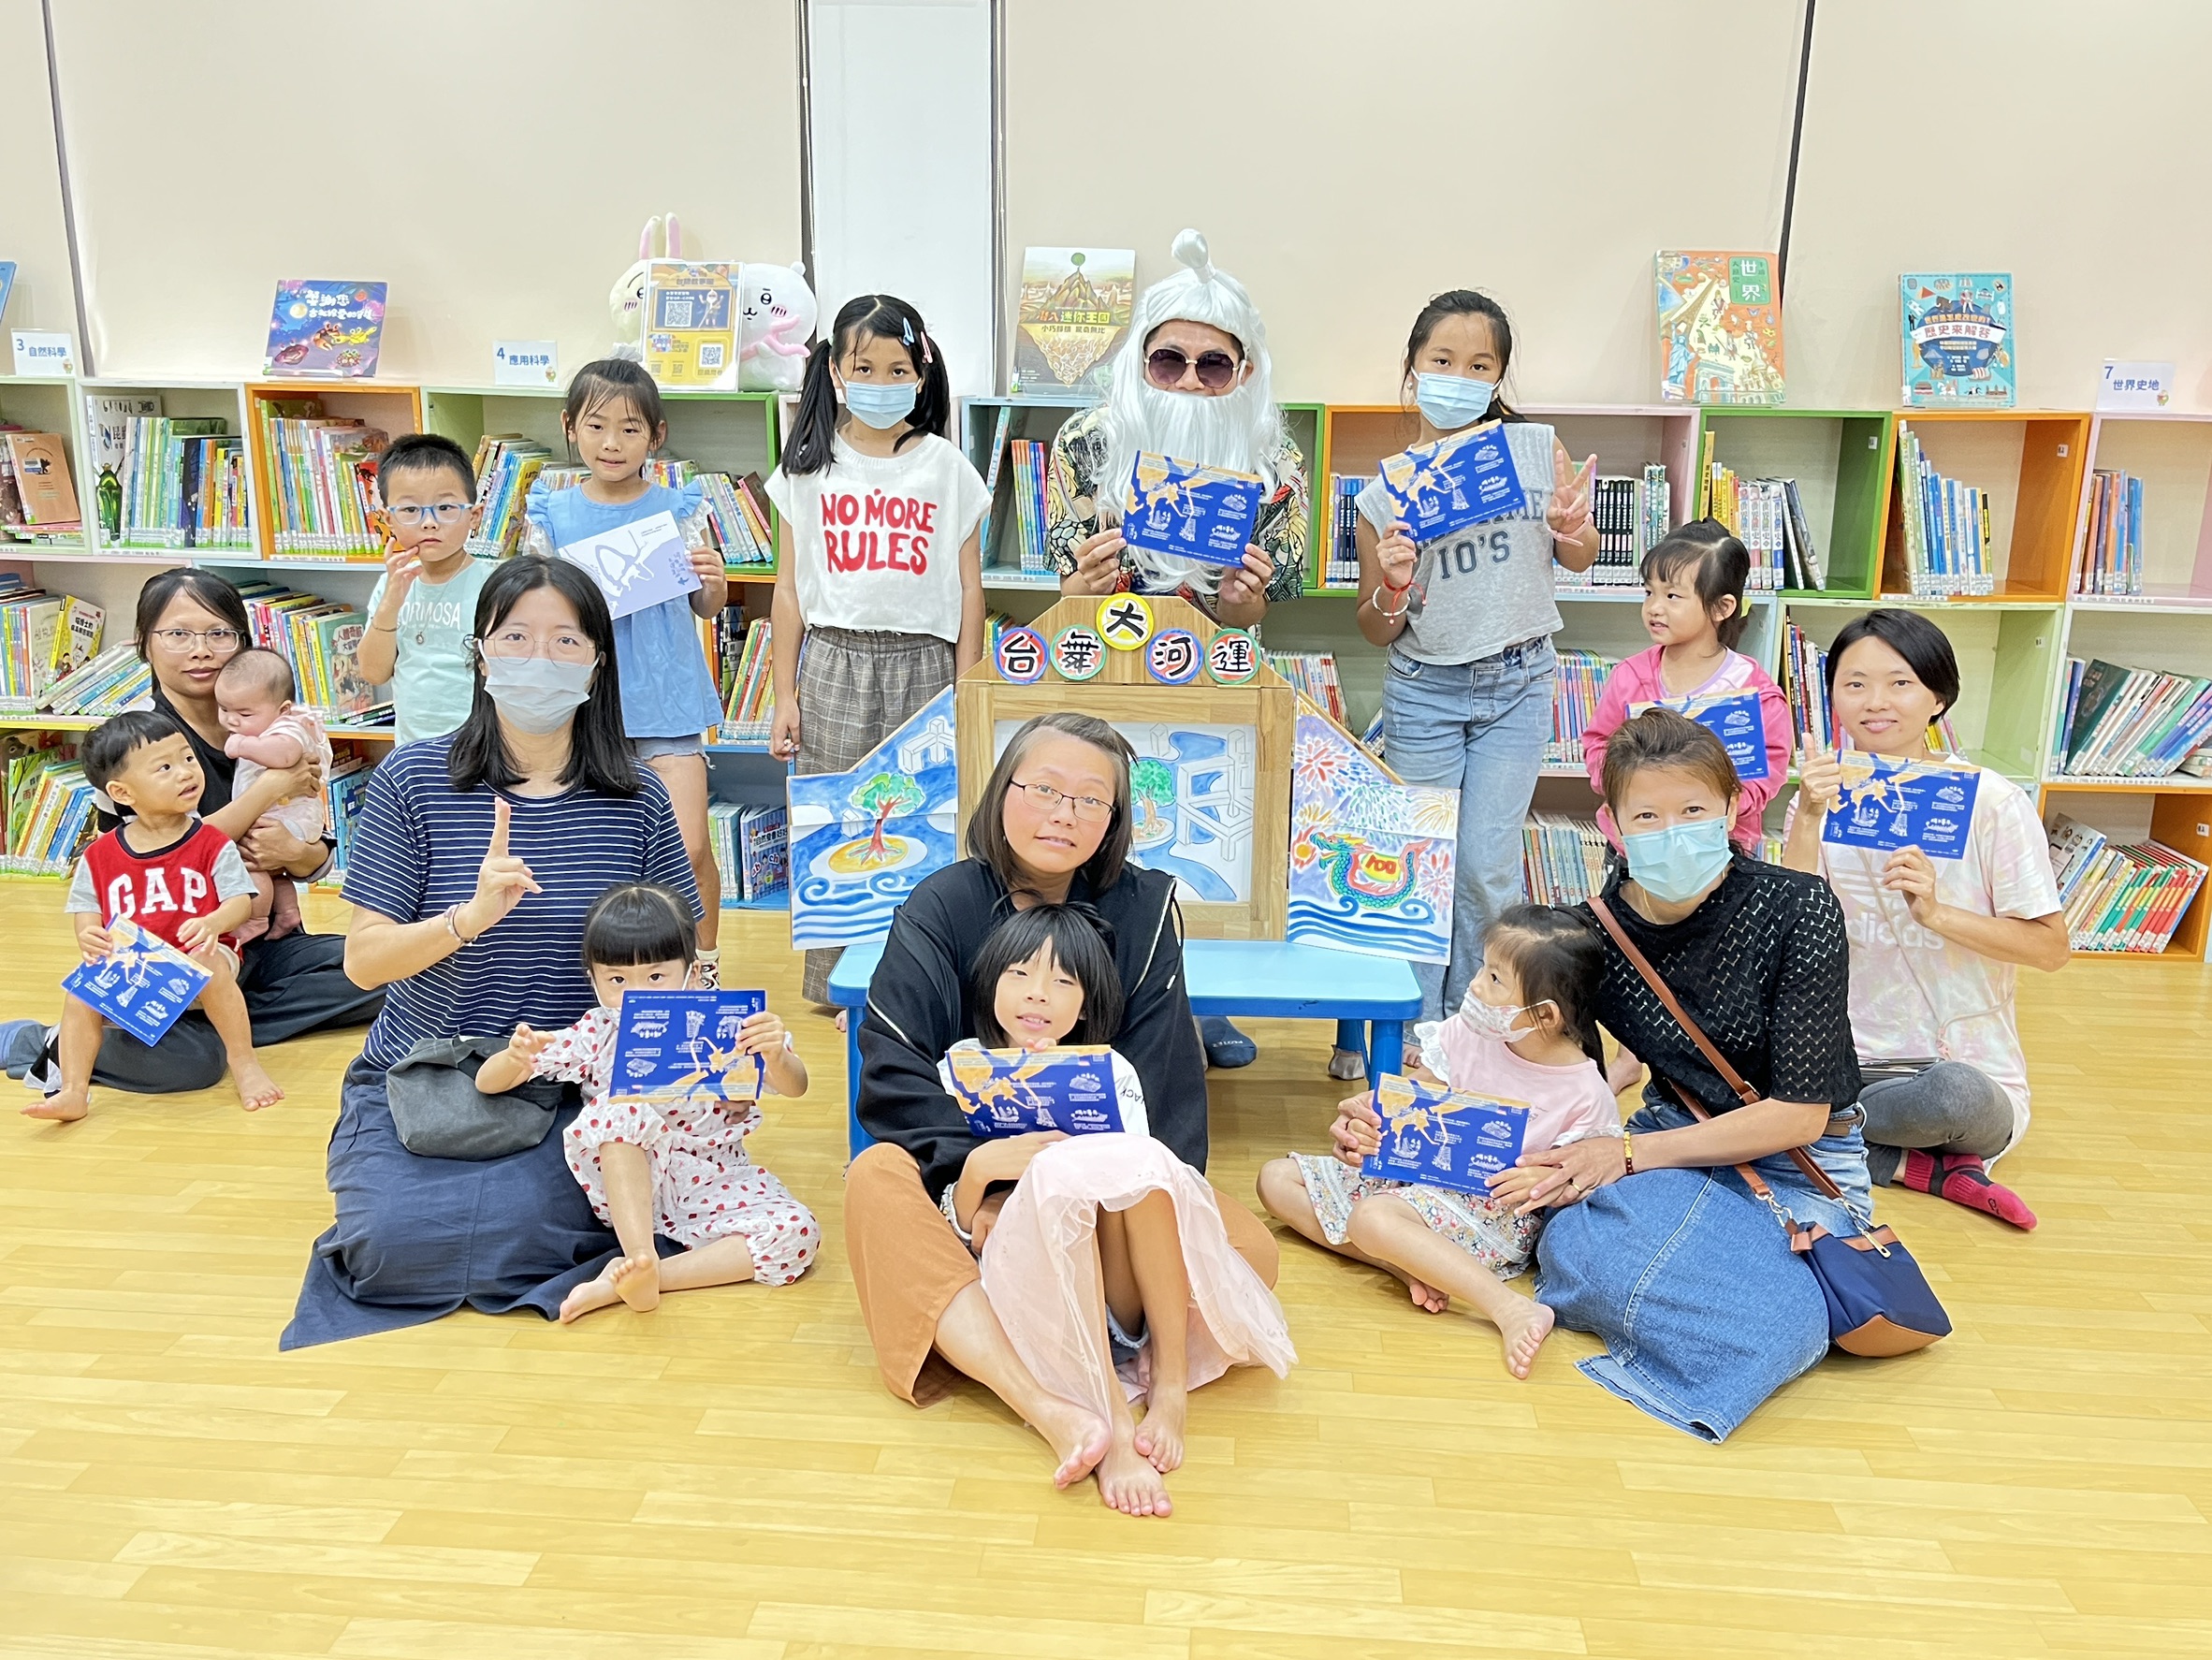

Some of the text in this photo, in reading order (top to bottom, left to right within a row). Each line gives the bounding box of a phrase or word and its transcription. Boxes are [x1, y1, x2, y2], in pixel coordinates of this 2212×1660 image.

[1740, 259, 1761, 301] 世界
[16, 339, 66, 357] 3 自然科學
[1925, 325, 1991, 339] 歷史來解答
[497, 347, 549, 366] 4 應用科學
[2104, 366, 2160, 391] 7 世界史地
[821, 493, 937, 533] NO MORE
[823, 530, 929, 575] RULES
[400, 601, 461, 632] ORMOSA
[109, 866, 208, 919] GAP
[1846, 912, 1944, 951] didas
